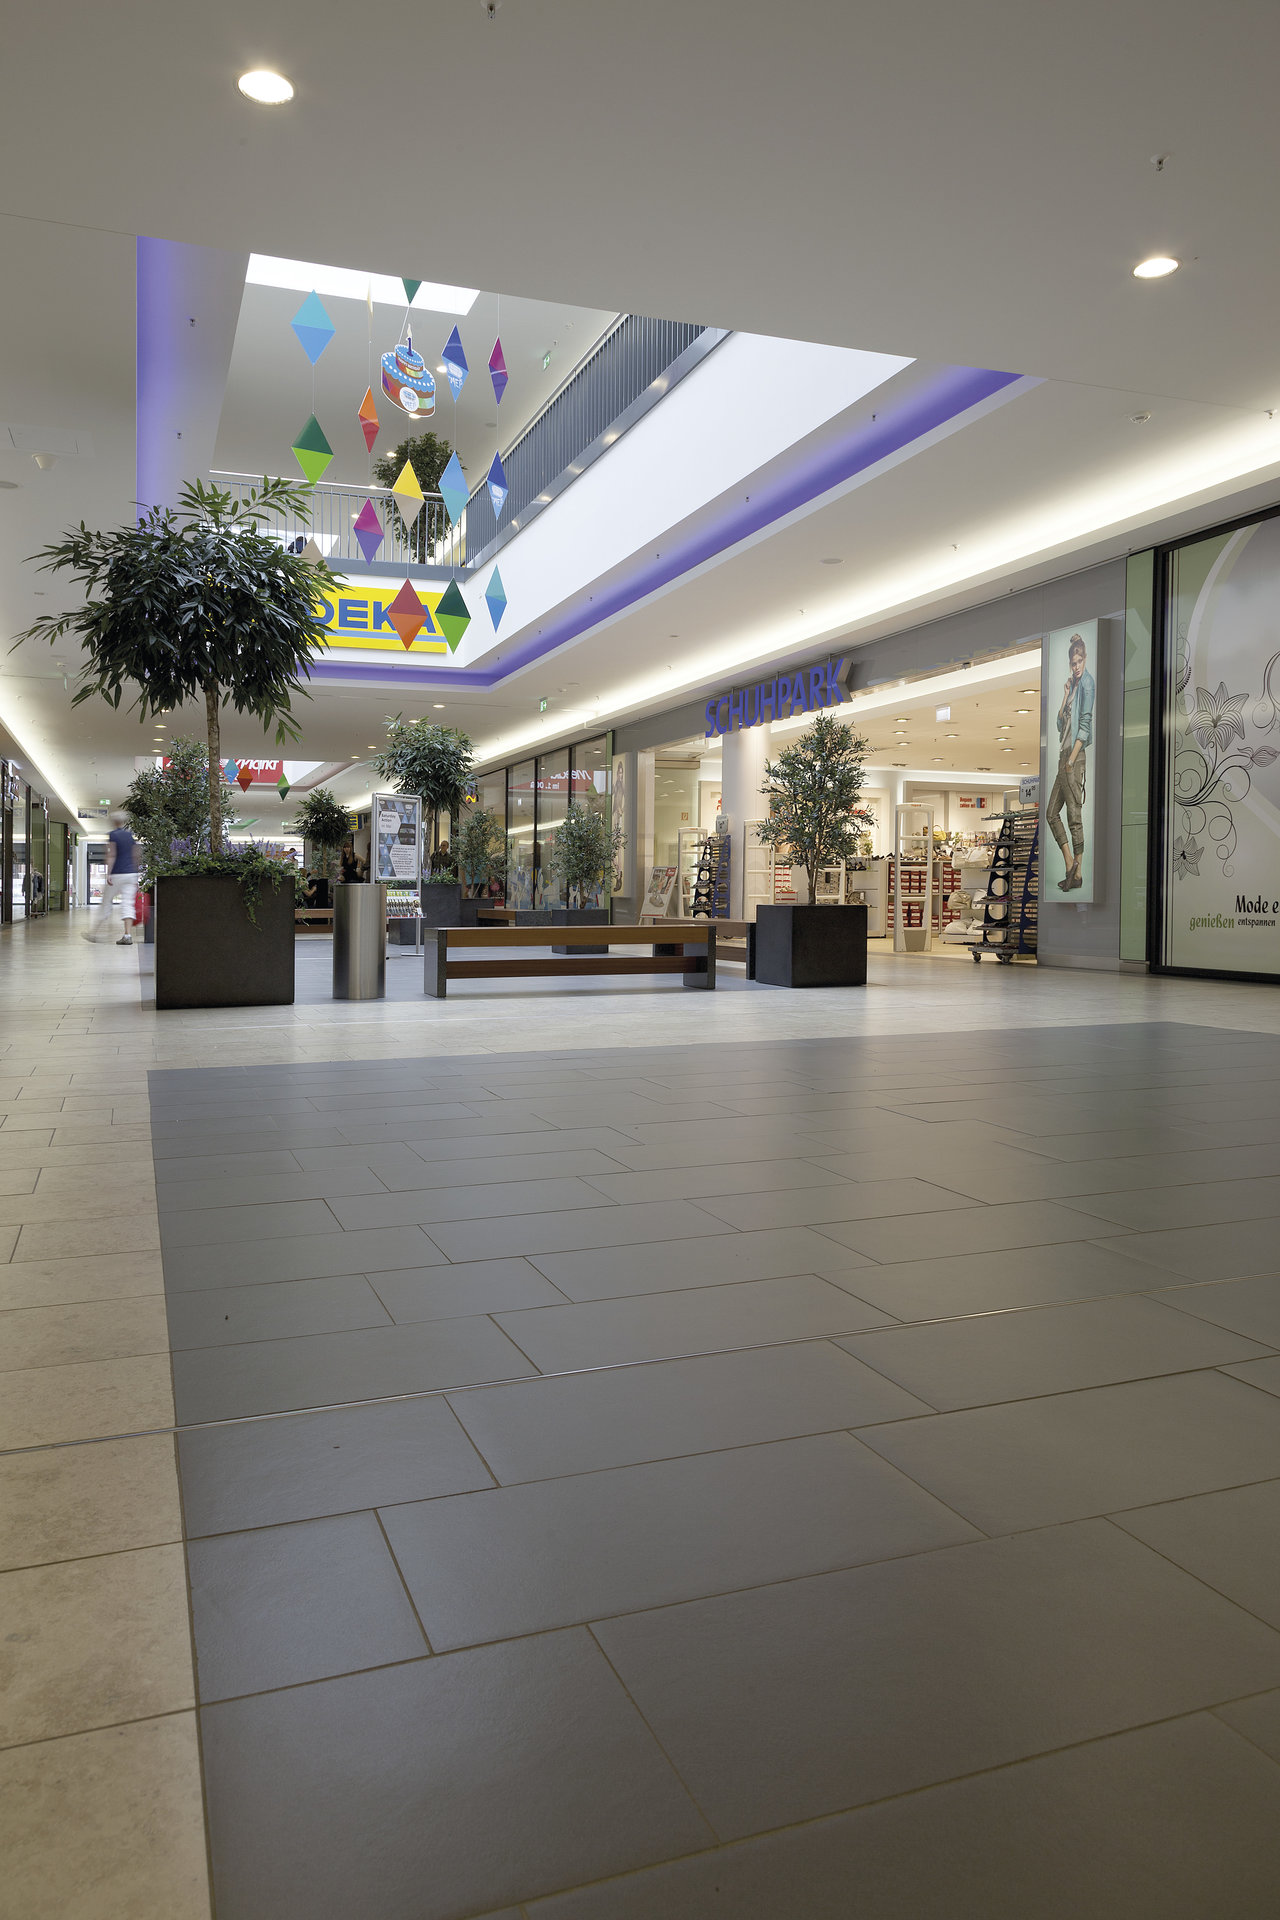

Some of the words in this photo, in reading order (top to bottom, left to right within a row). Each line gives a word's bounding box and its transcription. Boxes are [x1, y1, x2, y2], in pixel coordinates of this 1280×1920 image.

[705, 658, 844, 738] SCHUHPARK
[1235, 895, 1269, 914] Mode
[1189, 913, 1235, 932] genießen
[1237, 917, 1276, 928] entspannen
